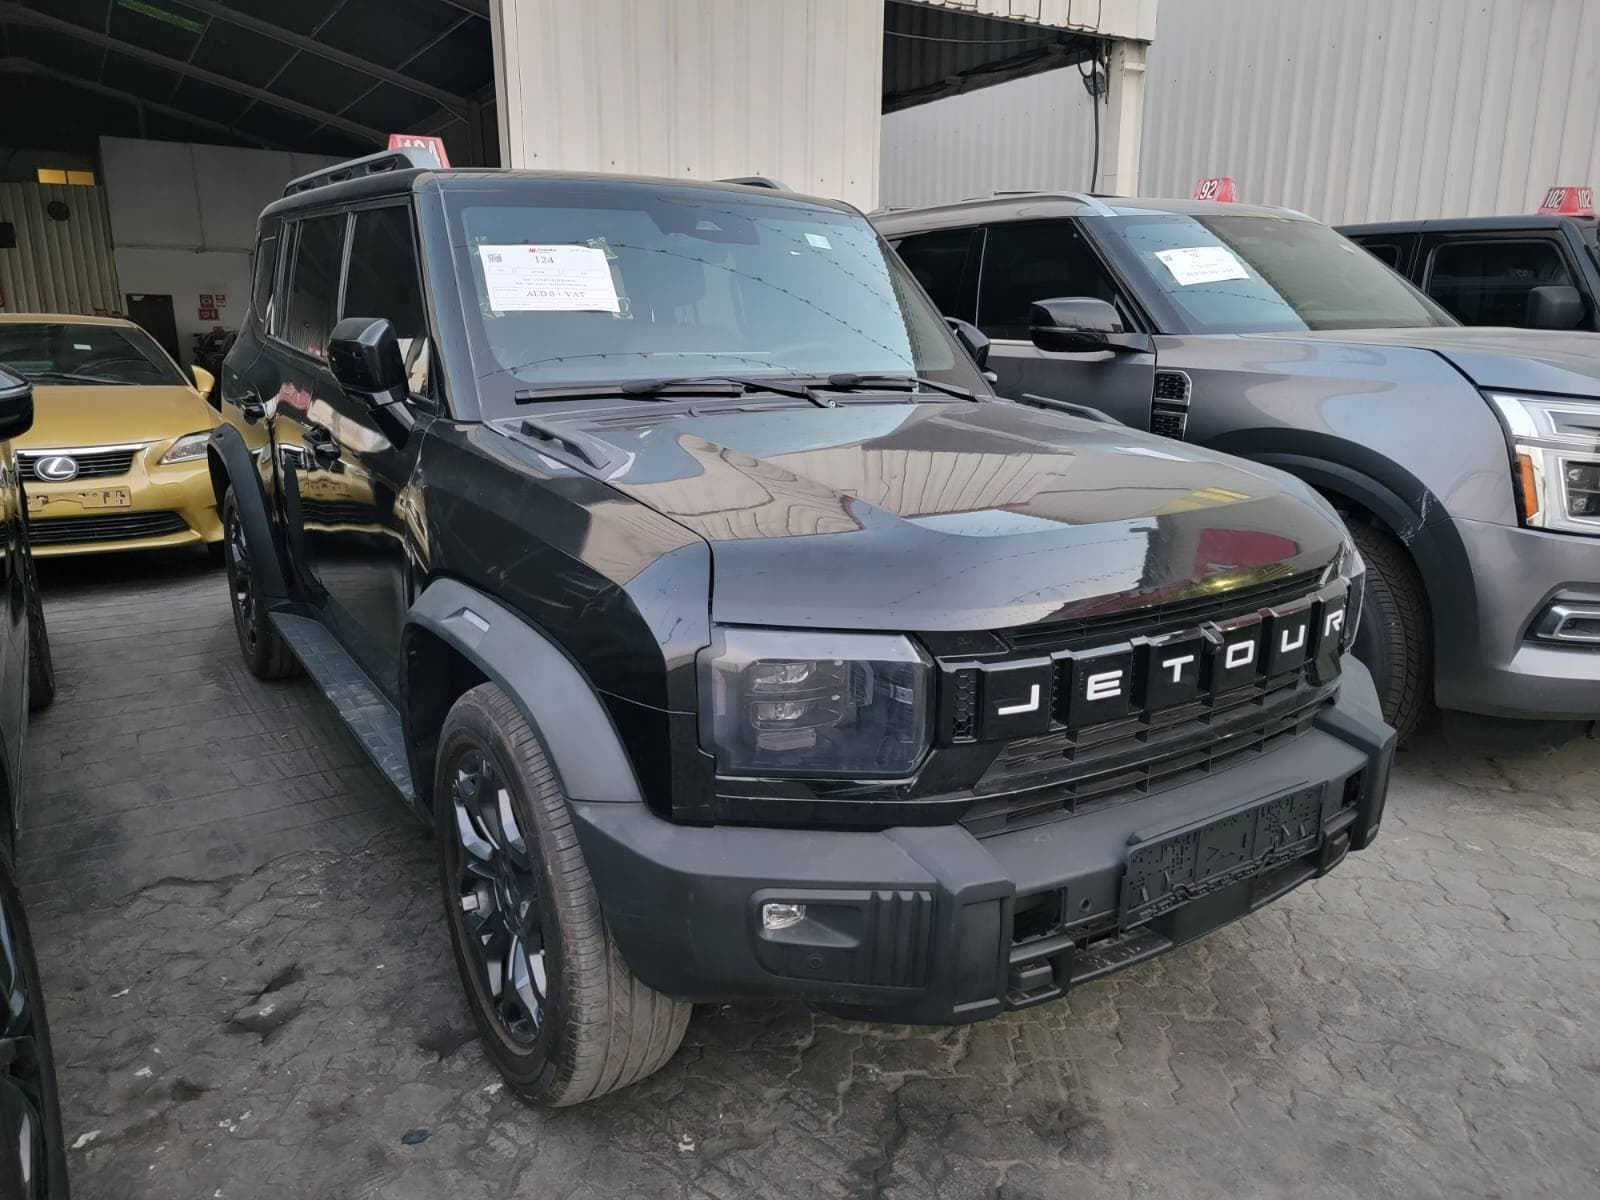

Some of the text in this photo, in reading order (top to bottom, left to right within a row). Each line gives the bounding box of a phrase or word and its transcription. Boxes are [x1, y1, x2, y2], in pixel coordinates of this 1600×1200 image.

[1199, 180, 1218, 200] 92
[1543, 189, 1566, 208] 102
[1577, 189, 1592, 208] 102
[535, 255, 554, 264] 124
[998, 608, 1344, 715] JETOUR
